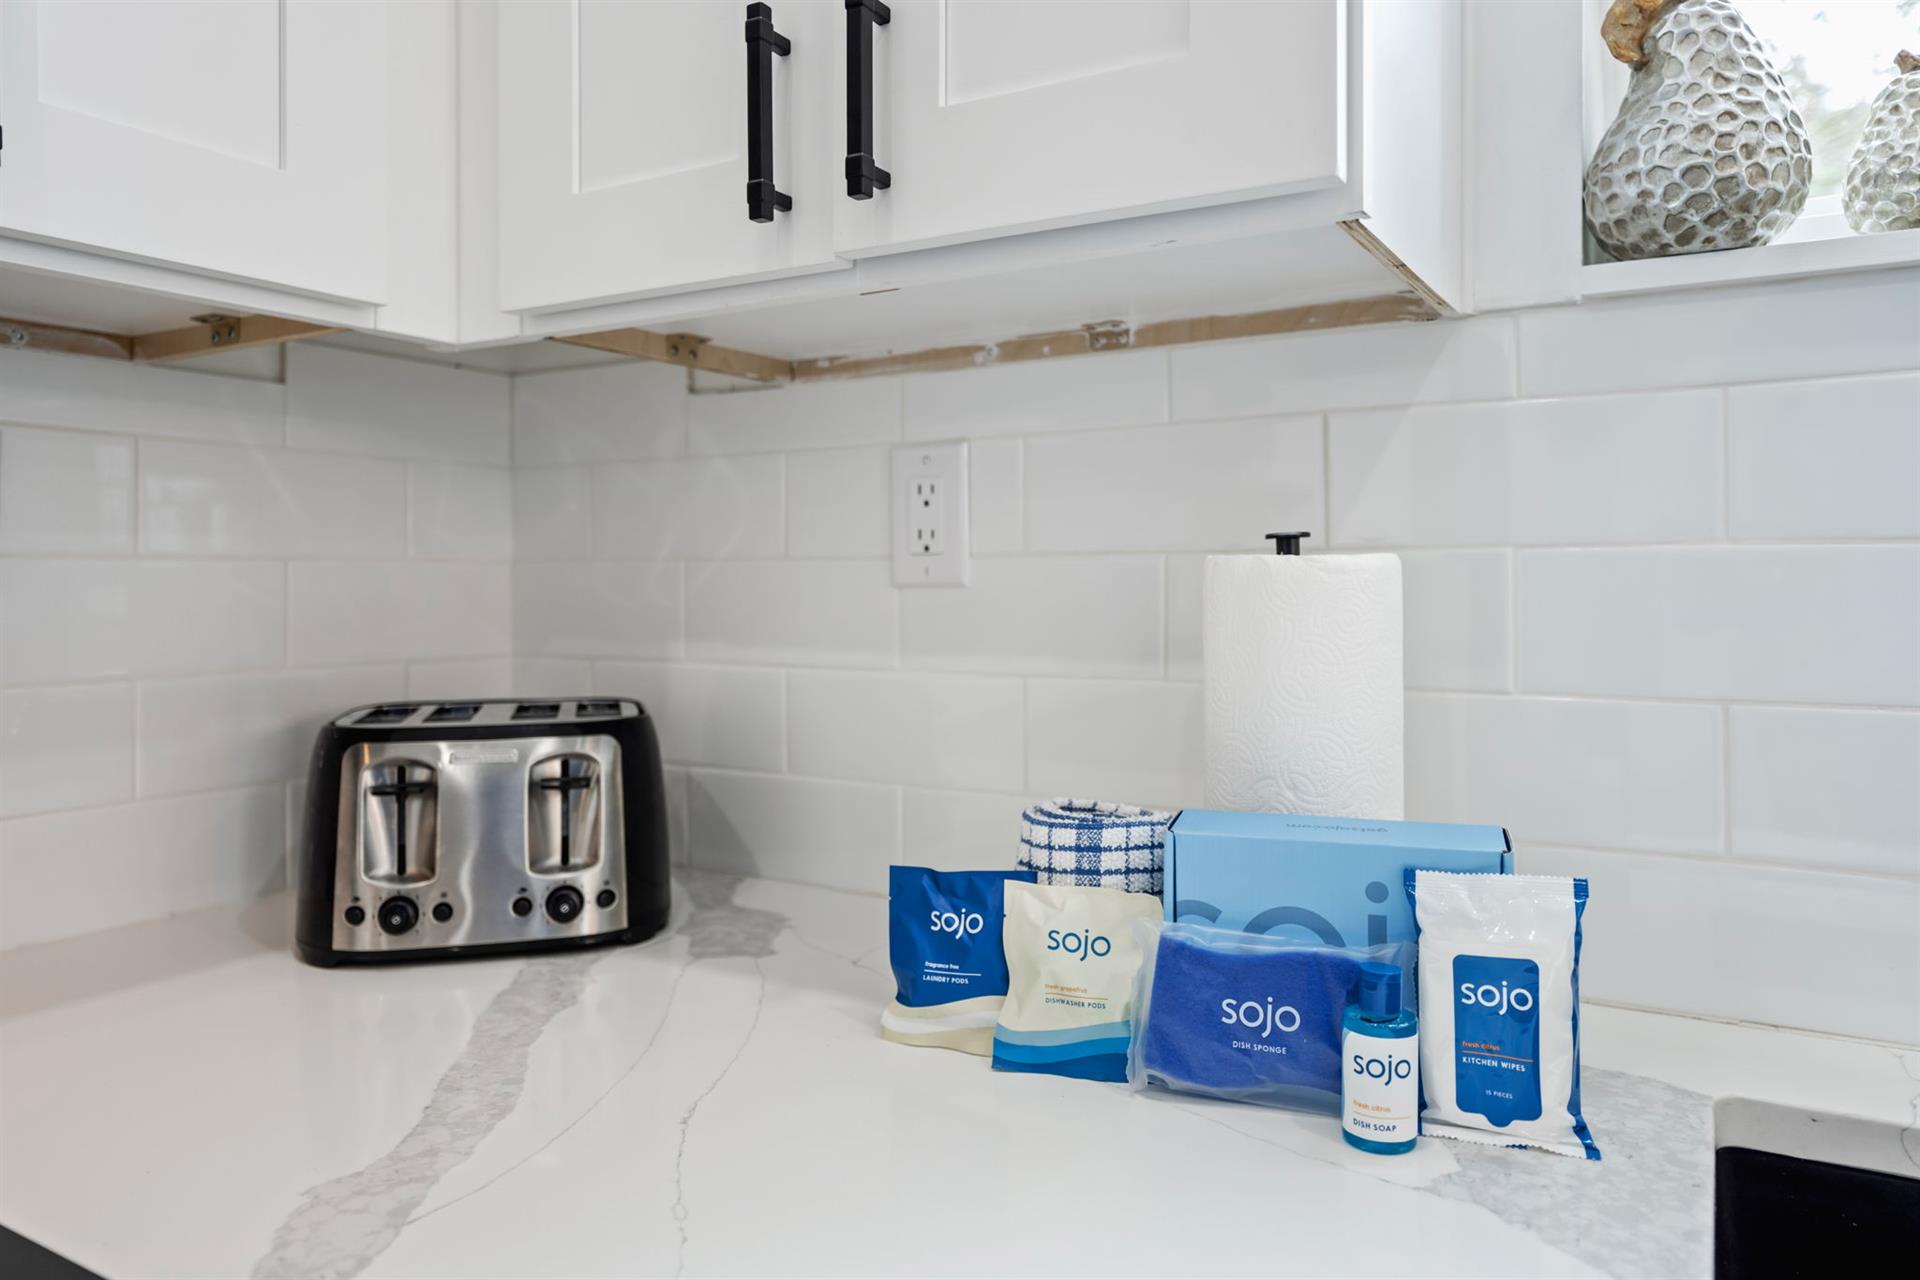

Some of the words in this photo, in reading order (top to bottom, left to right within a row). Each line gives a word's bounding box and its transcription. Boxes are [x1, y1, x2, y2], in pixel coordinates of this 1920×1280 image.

[930, 908, 984, 940] sojo
[1047, 929, 1112, 962] sojo
[922, 974, 950, 983] LAUNDRY
[951, 977, 969, 985] PODS
[1045, 997, 1086, 1008] DISHWASHER
[1087, 1001, 1106, 1010] PODS
[1460, 980, 1534, 1016] sojo
[1220, 996, 1301, 1039] sojo
[1232, 1040, 1251, 1050] DISH
[1253, 1043, 1287, 1055] SPONGE
[1353, 1054, 1412, 1086] sojo
[1462, 1056, 1499, 1068] KITCHEN
[1500, 1061, 1526, 1072] WIPES
[1353, 1117, 1371, 1129] DISH
[1373, 1123, 1397, 1132] SOAP
